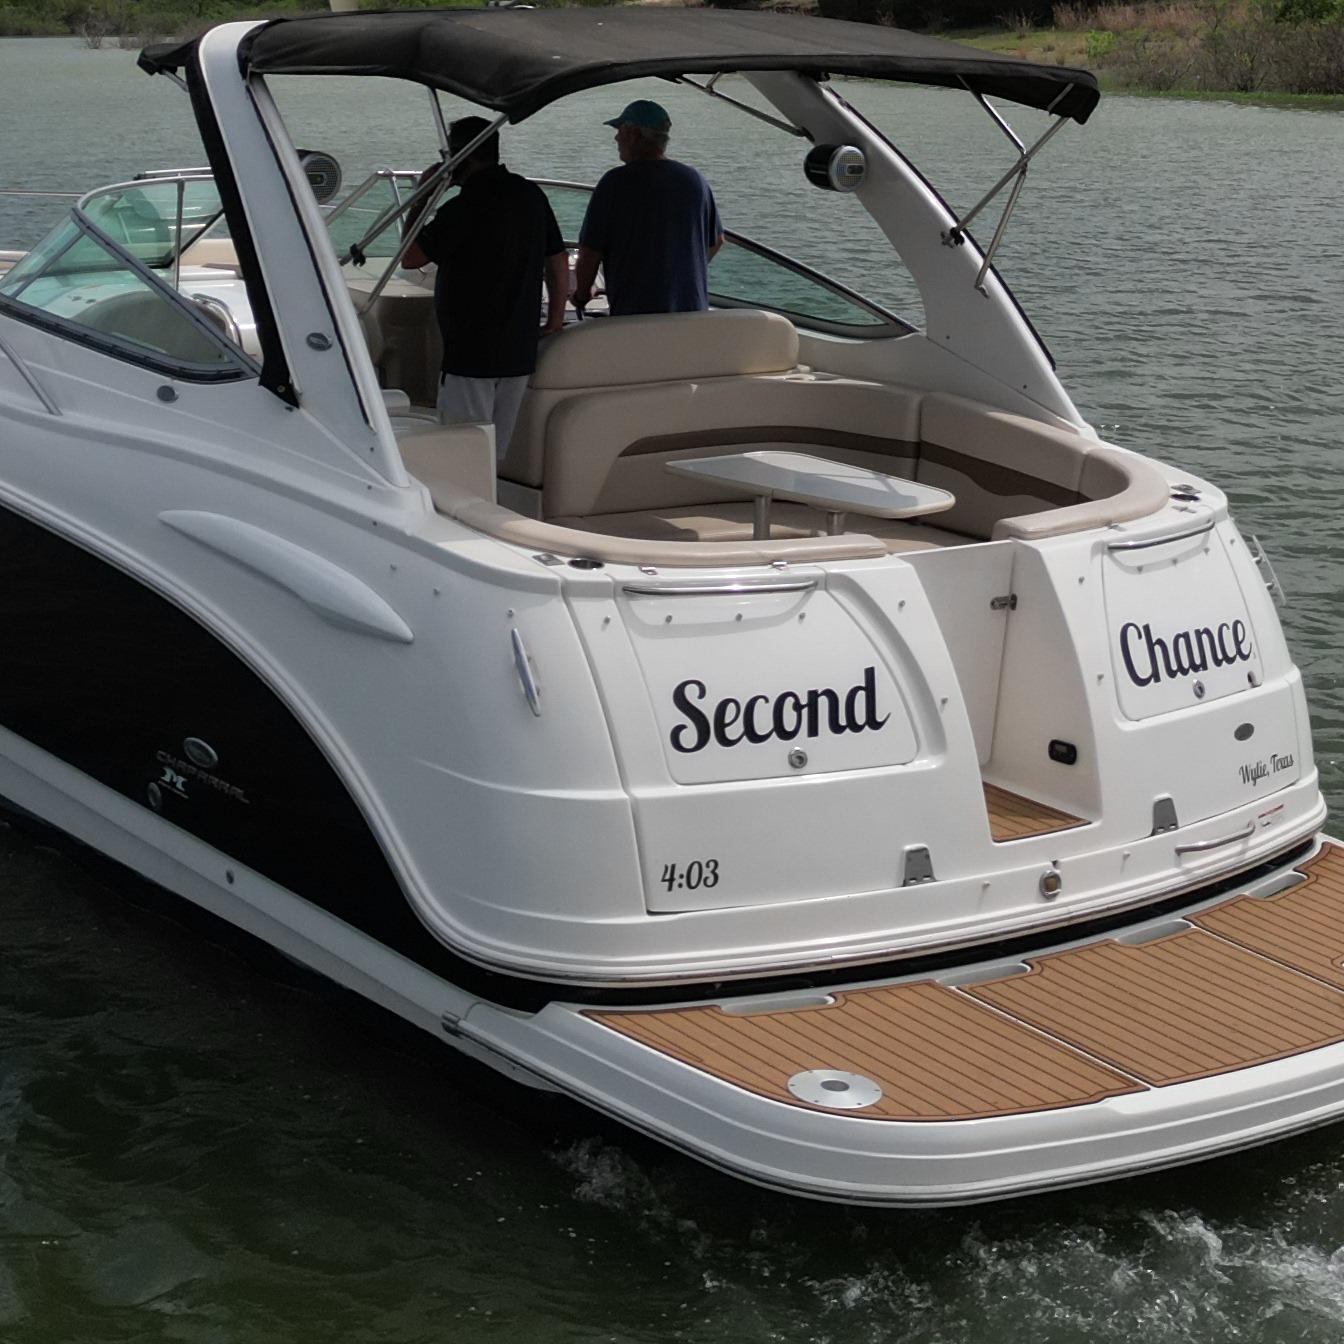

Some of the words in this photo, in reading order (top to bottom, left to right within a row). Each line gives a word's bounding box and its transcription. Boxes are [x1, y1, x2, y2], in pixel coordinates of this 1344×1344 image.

[669, 666, 891, 754] Second
[1119, 619, 1253, 687] Chance
[1238, 759, 1270, 787] Wylie,
[1270, 753, 1294, 773] Texas
[660, 858, 719, 892] 4:03
